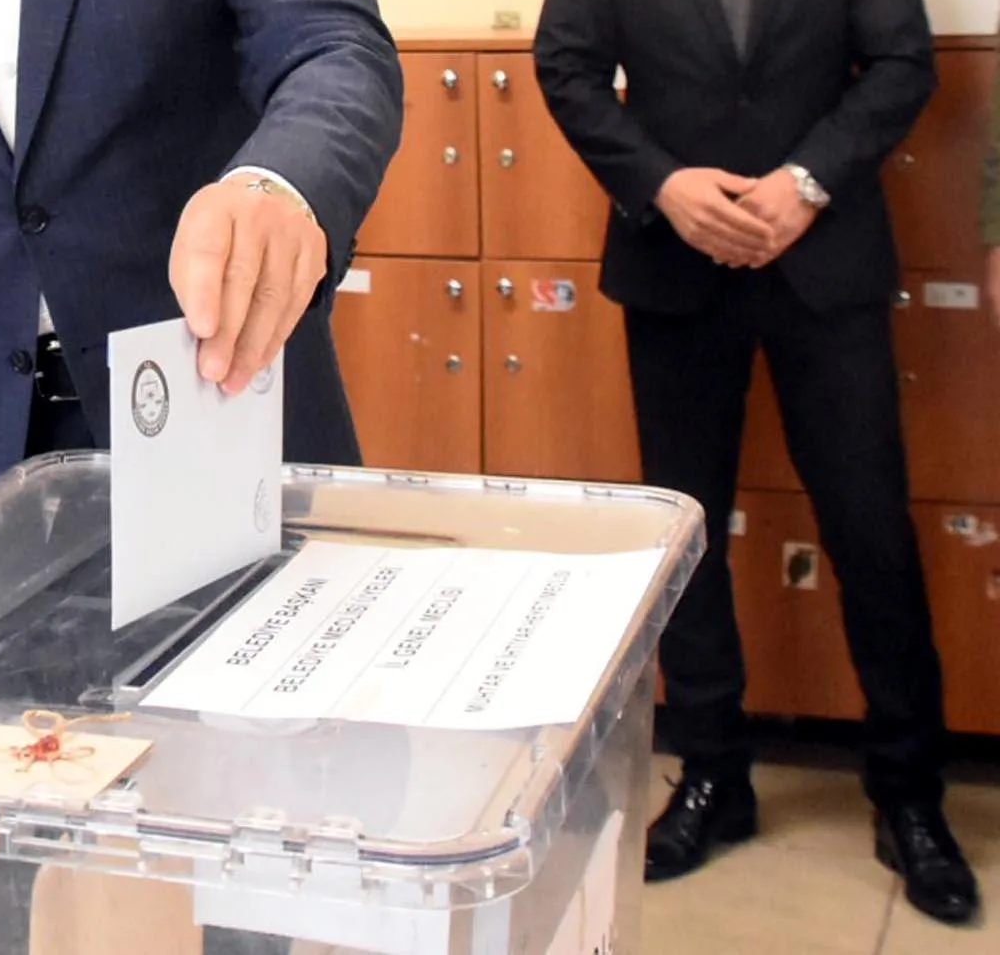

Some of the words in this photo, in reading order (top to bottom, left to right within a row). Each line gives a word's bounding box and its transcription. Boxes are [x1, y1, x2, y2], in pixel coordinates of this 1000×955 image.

[226, 617, 290, 665] BELEDİYE
[393, 624, 437, 657] GENEL
[273, 642, 337, 692] BELEDİYE
